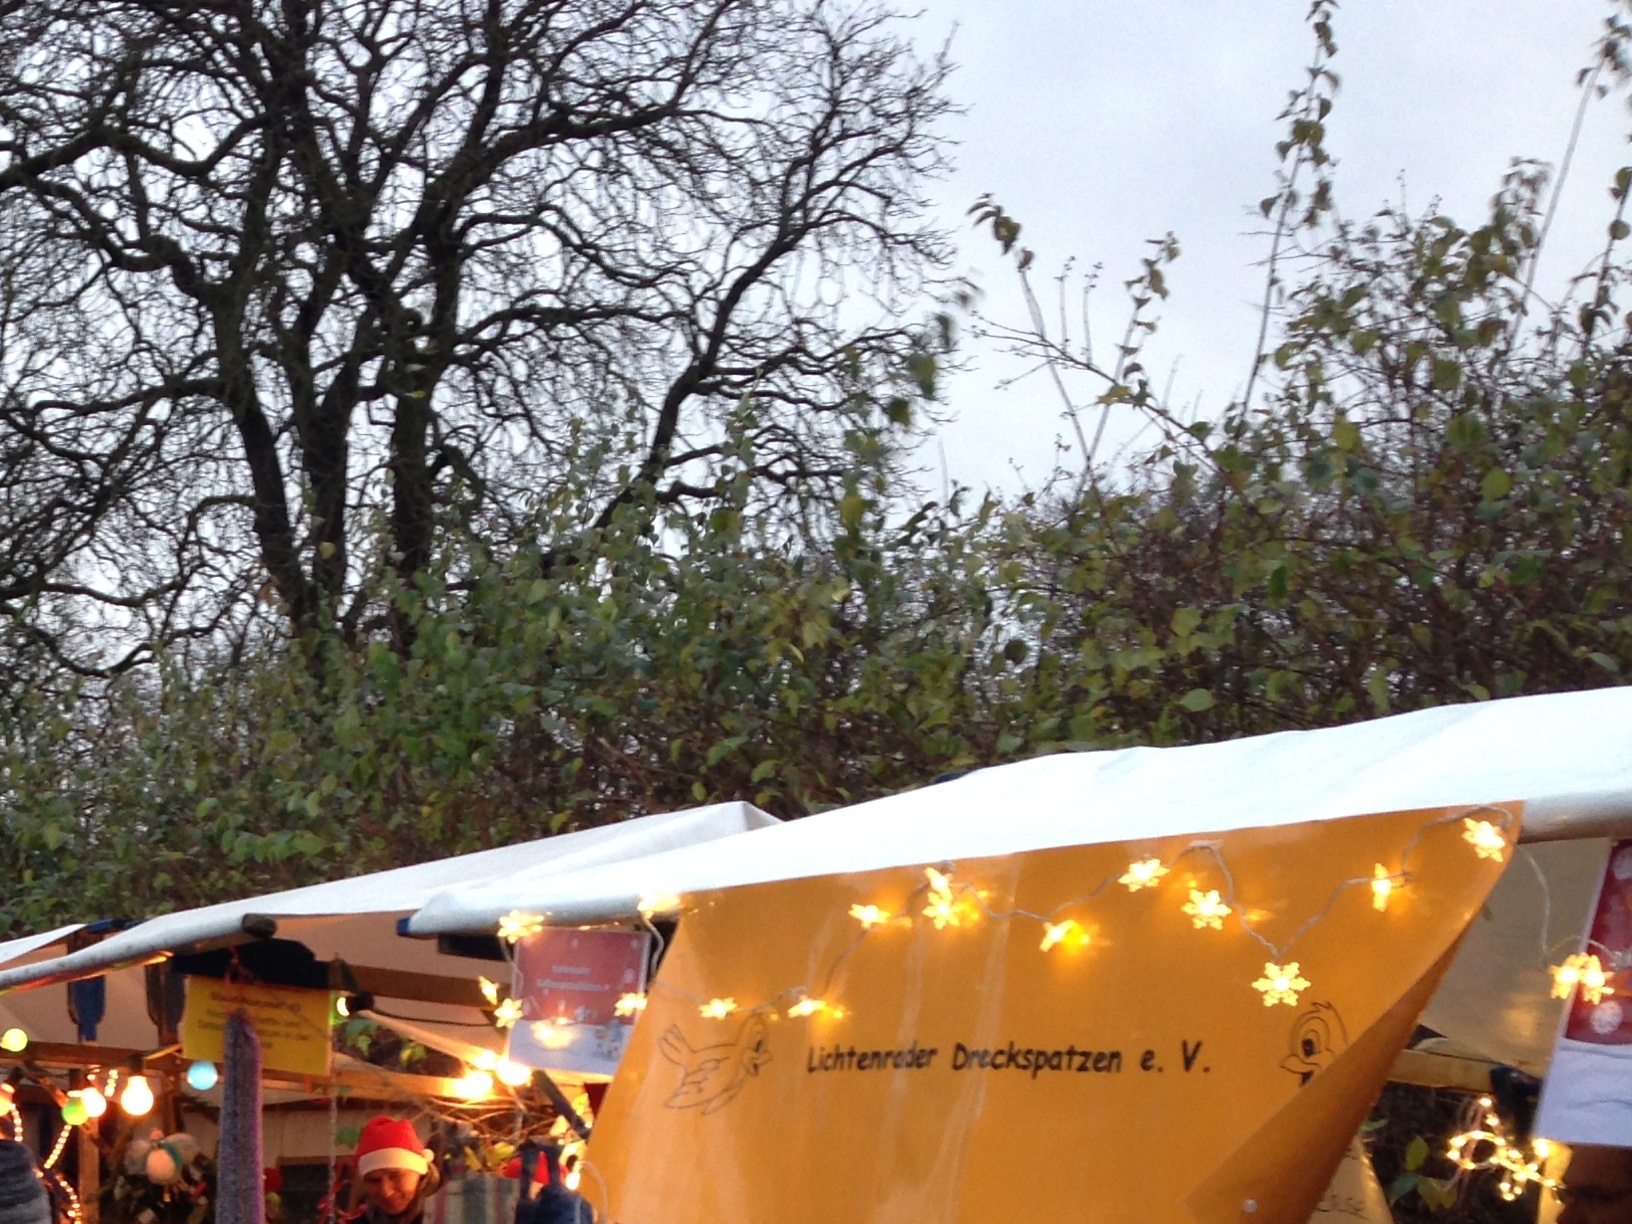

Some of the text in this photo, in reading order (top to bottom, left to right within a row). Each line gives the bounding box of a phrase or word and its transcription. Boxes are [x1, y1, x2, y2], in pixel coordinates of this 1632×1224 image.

[806, 1039, 1211, 1080] Lichtenrader Dreckspatzen e. V.
